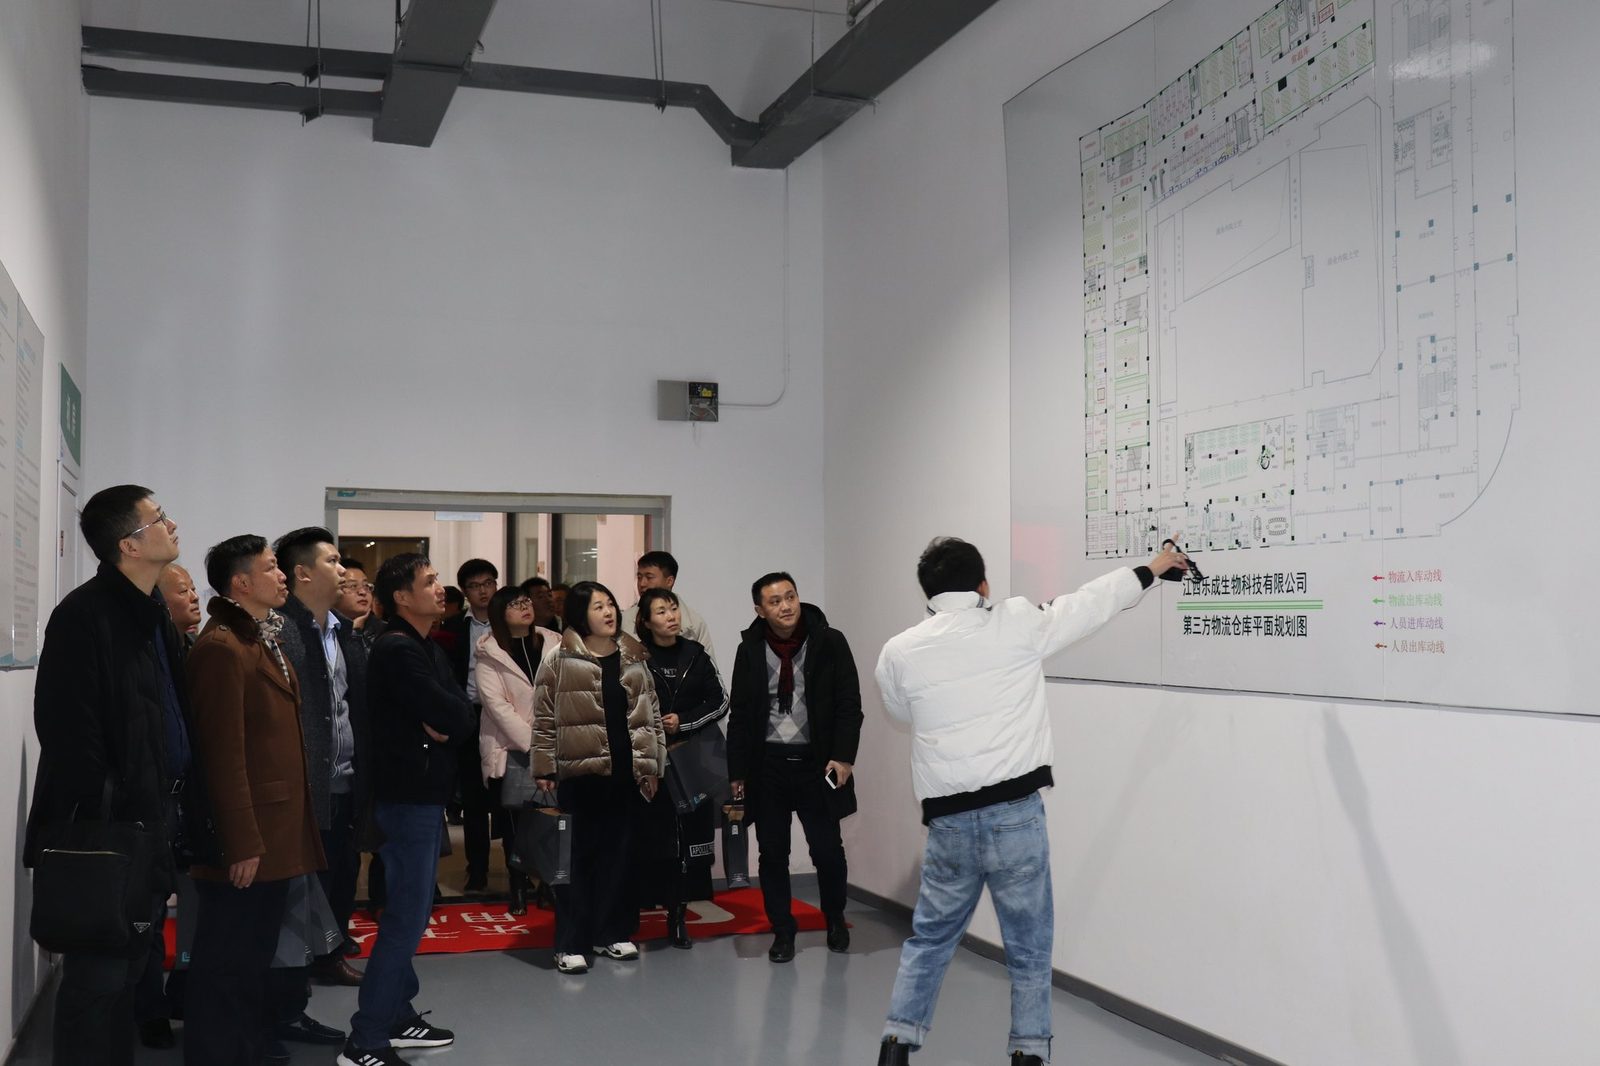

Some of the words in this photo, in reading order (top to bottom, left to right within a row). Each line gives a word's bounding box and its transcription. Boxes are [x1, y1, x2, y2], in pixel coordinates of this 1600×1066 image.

[1388, 569, 1443, 583] 物流入库动线
[1183, 572, 1307, 596] 江西乐成生物科技有限公司
[1388, 593, 1443, 607] 物流出库动线
[1183, 615, 1308, 638] 第三方物流仓库平面规划图
[1390, 616, 1444, 630] 人员进库动线
[1391, 639, 1446, 654] 人员出库动线
